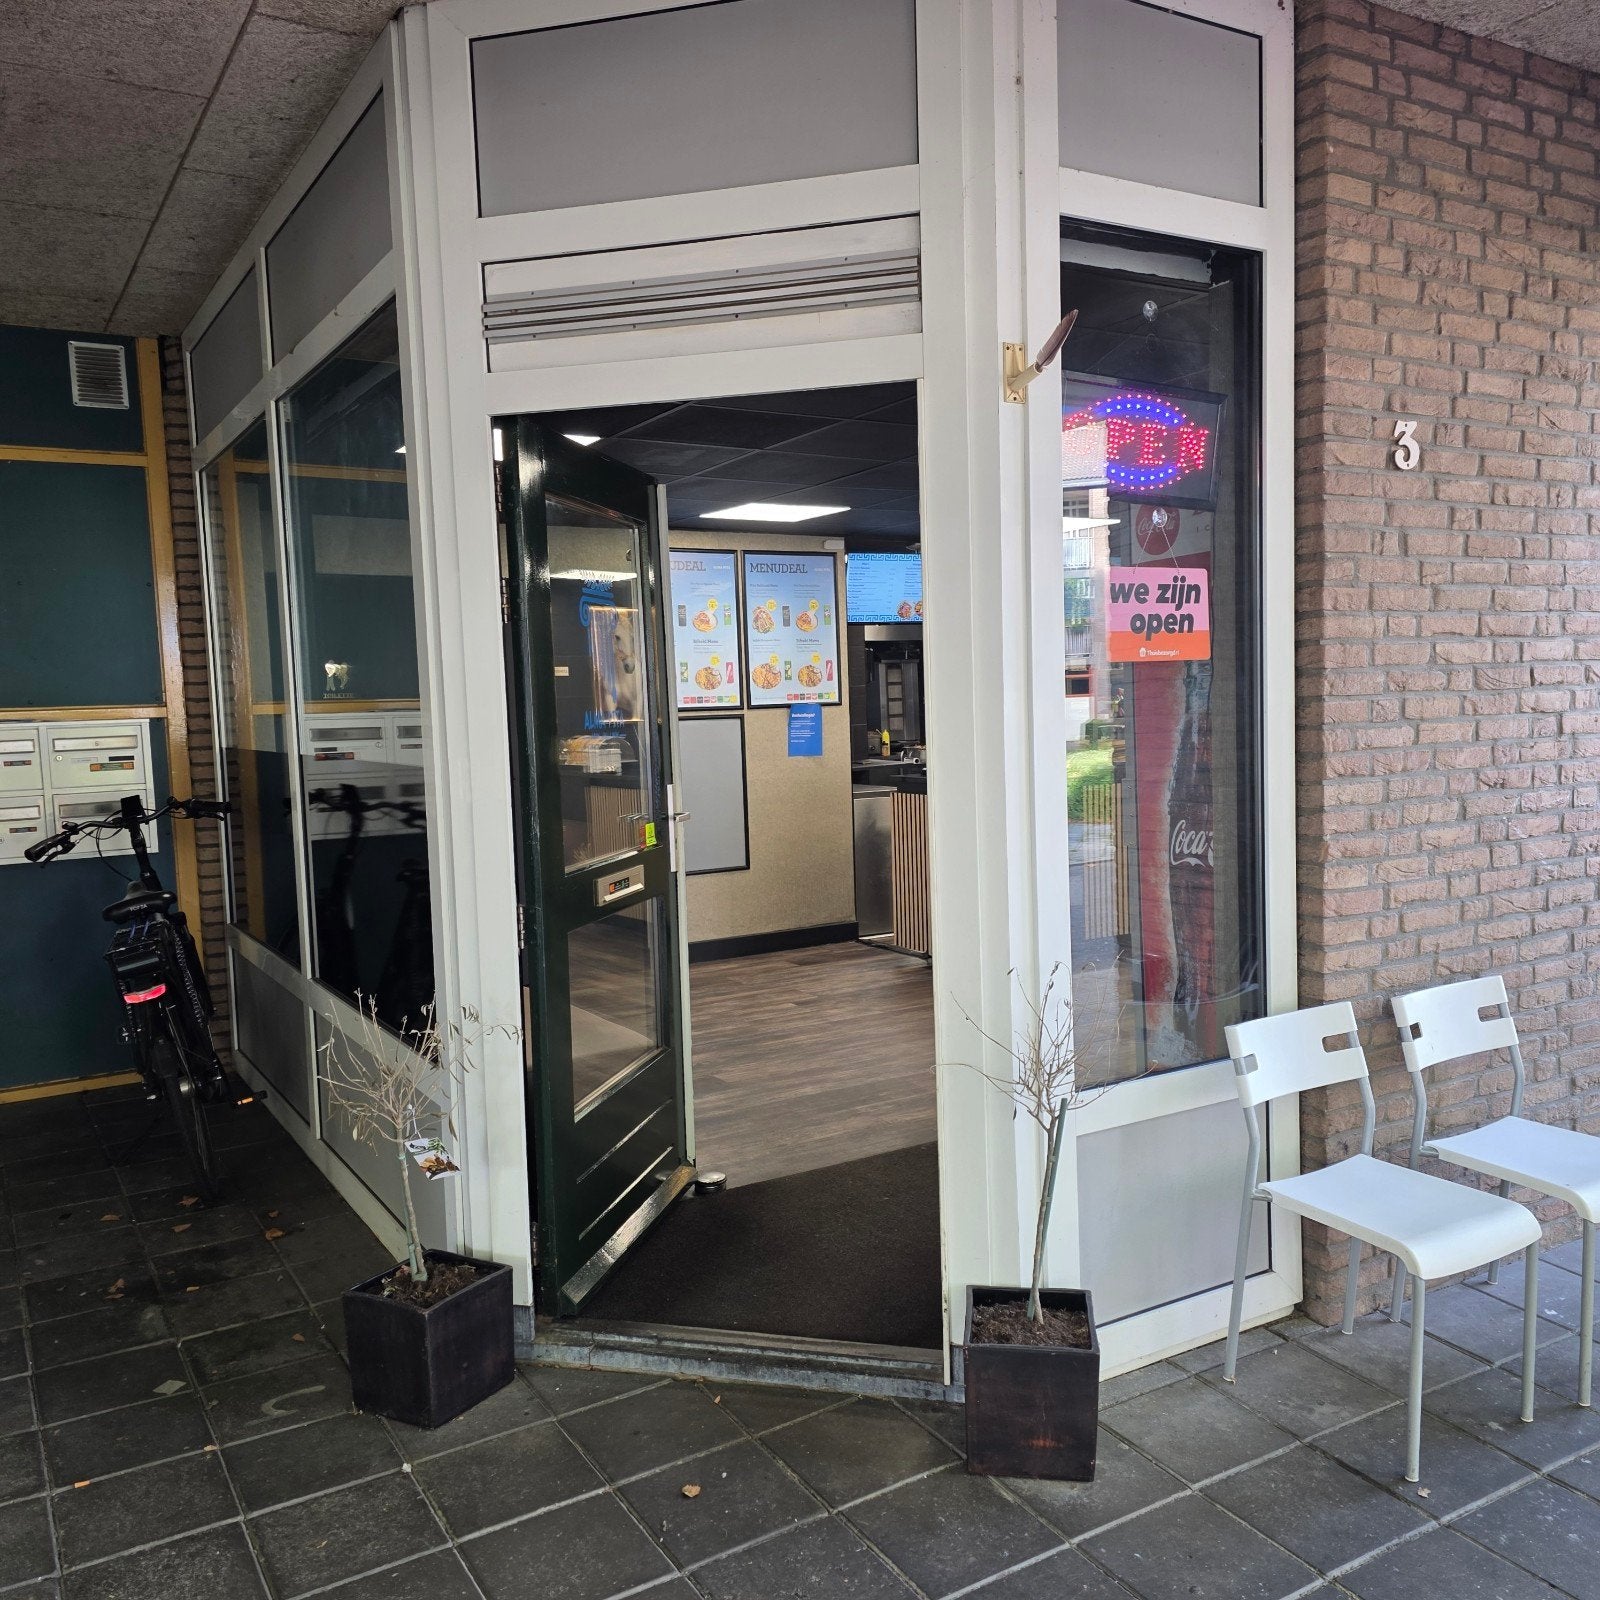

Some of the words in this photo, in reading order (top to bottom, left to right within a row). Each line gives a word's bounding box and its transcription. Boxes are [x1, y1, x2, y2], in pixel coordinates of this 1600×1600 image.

[1062, 412, 1210, 469] OPEN
[1394, 420, 1420, 470] 3
[670, 560, 707, 572] UDEAL
[750, 562, 808, 574] MENUDEAL
[1110, 583, 1150, 605] we
[1156, 575, 1201, 611] zijn
[1130, 613, 1195, 642] open
